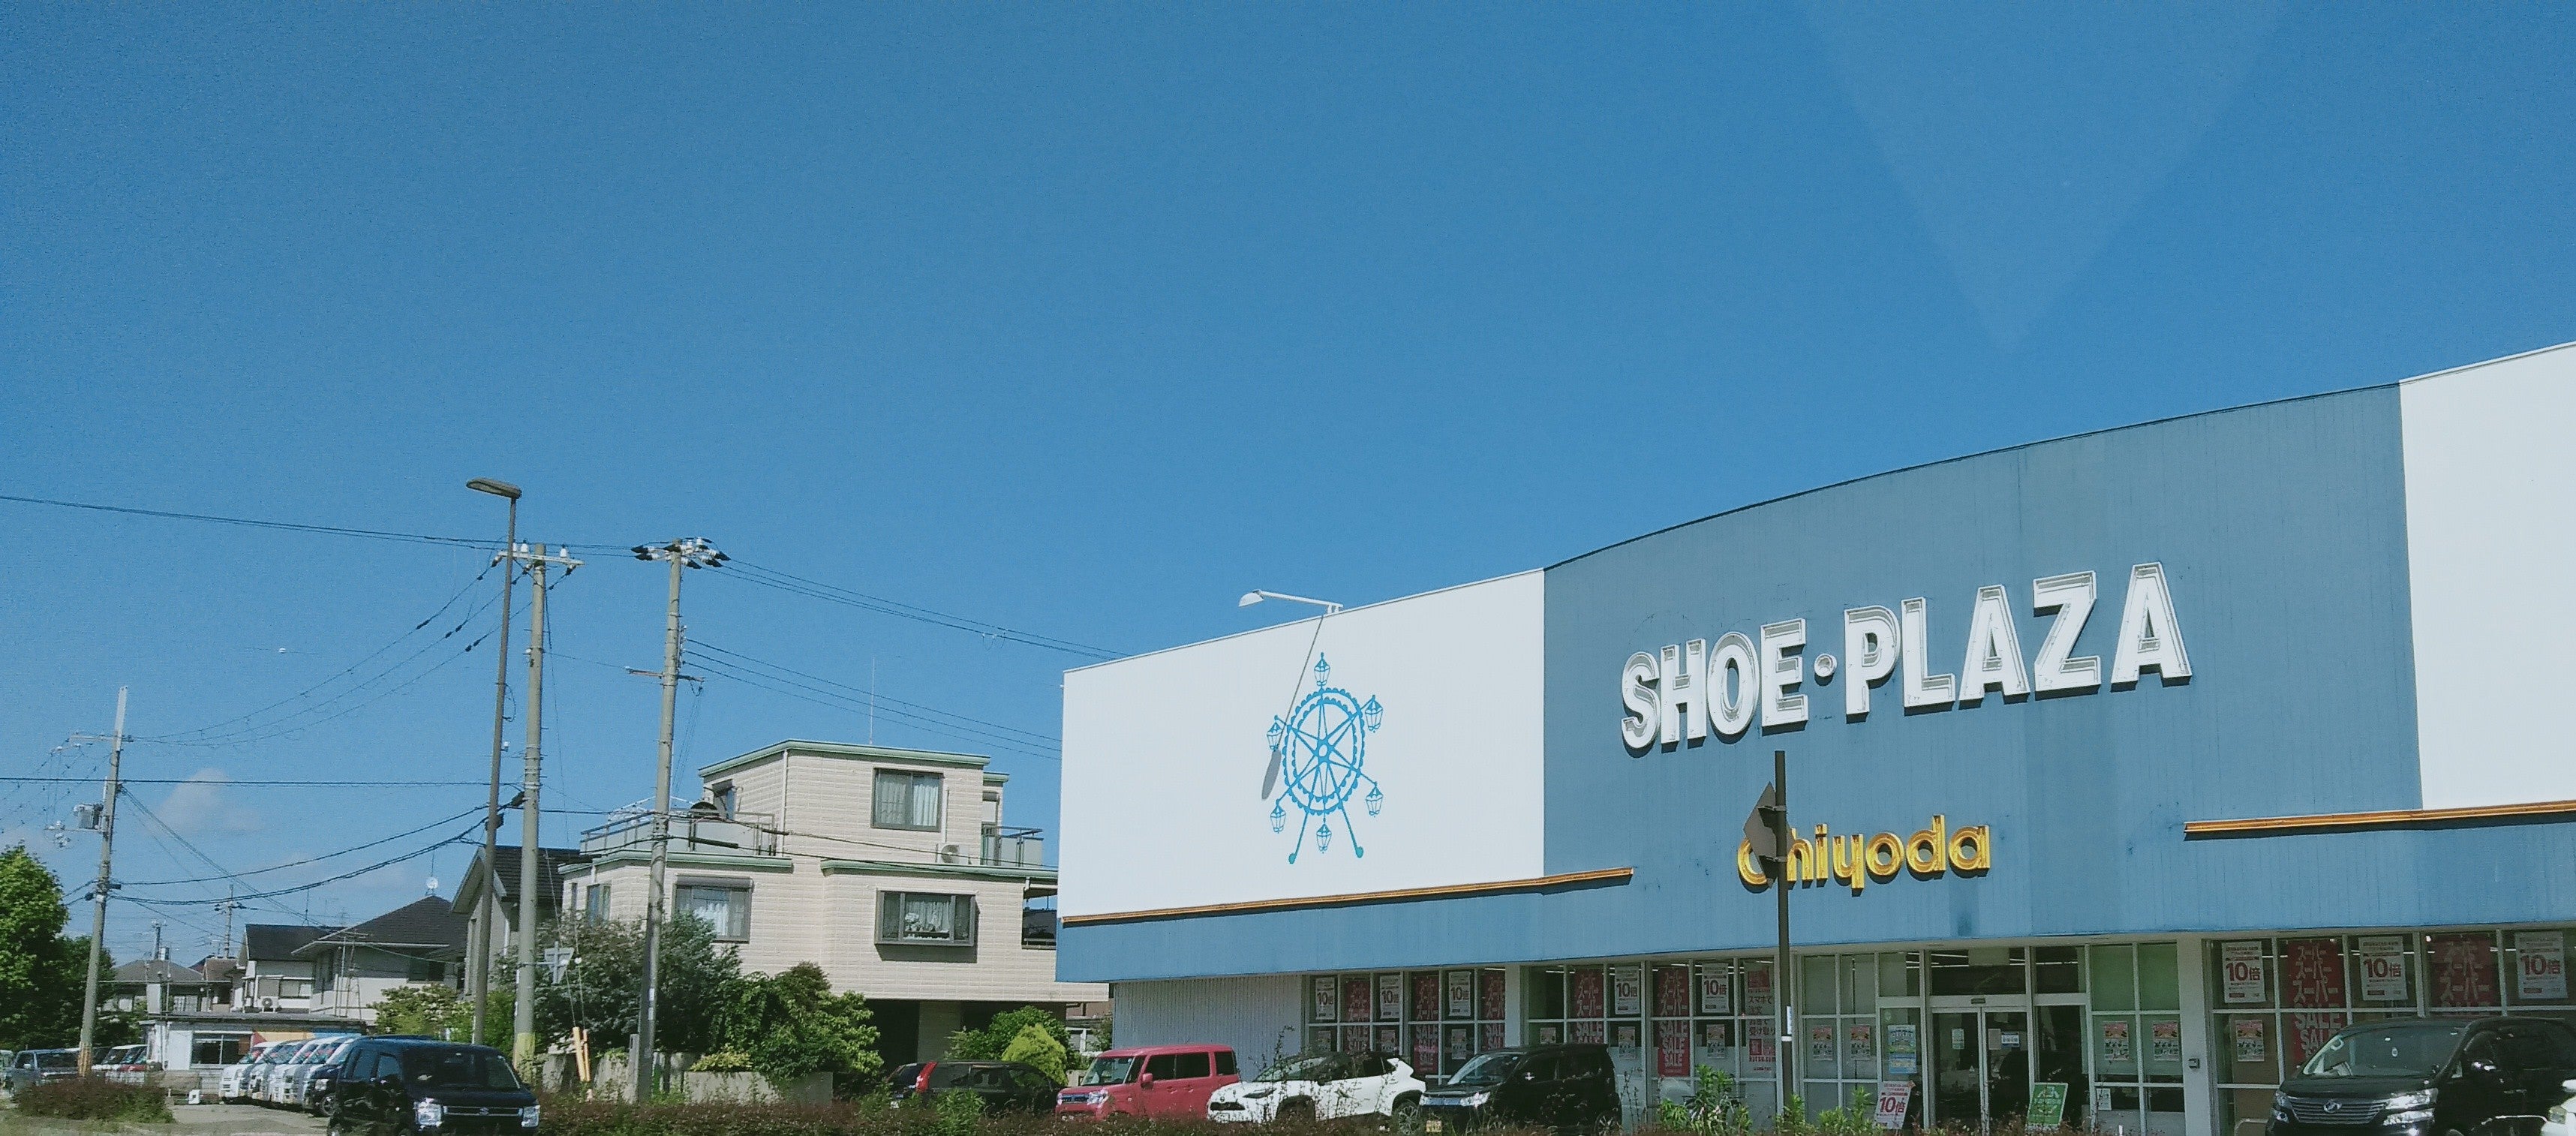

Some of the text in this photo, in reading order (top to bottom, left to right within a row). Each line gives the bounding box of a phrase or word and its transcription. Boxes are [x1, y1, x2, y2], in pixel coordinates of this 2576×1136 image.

[2364, 957, 2402, 978] 10倍
[2520, 954, 2561, 975] 10倍
[1880, 1096, 1905, 1113] 10倍
